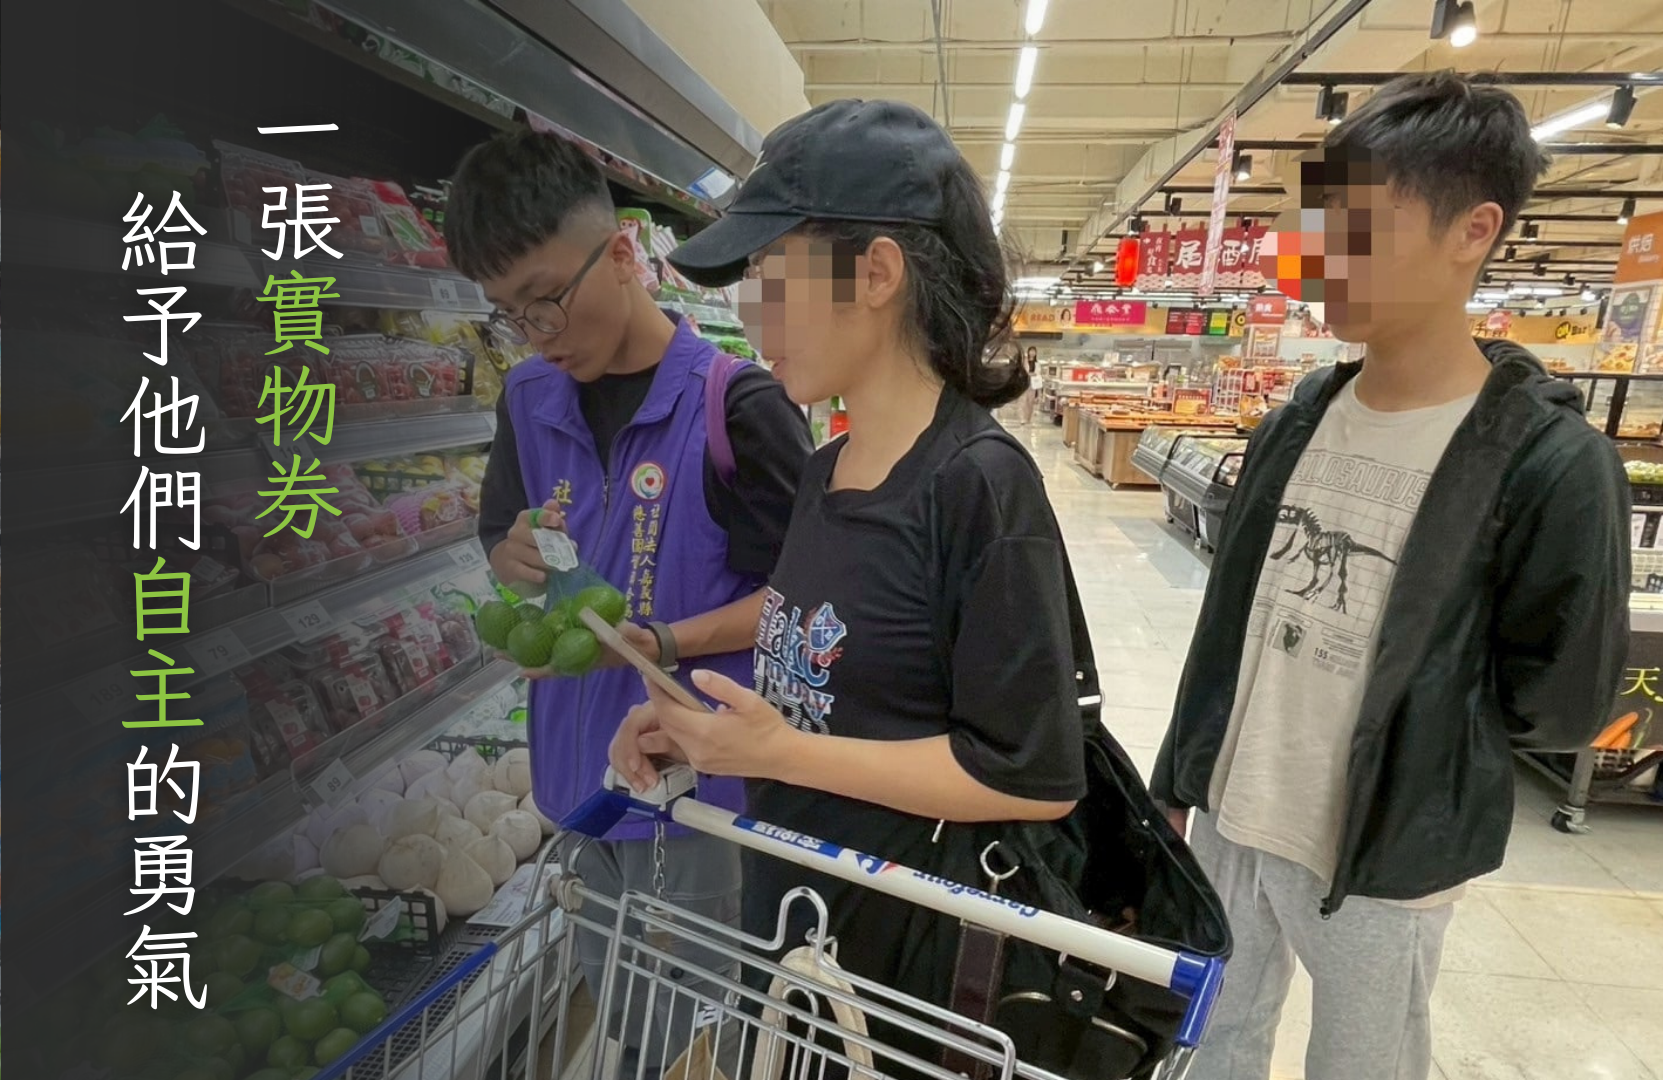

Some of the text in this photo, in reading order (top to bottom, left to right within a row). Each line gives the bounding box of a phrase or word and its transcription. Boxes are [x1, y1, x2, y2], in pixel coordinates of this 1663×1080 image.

[298, 613, 321, 629] 129
[209, 645, 229, 661] 79
[326, 775, 342, 793] 89
